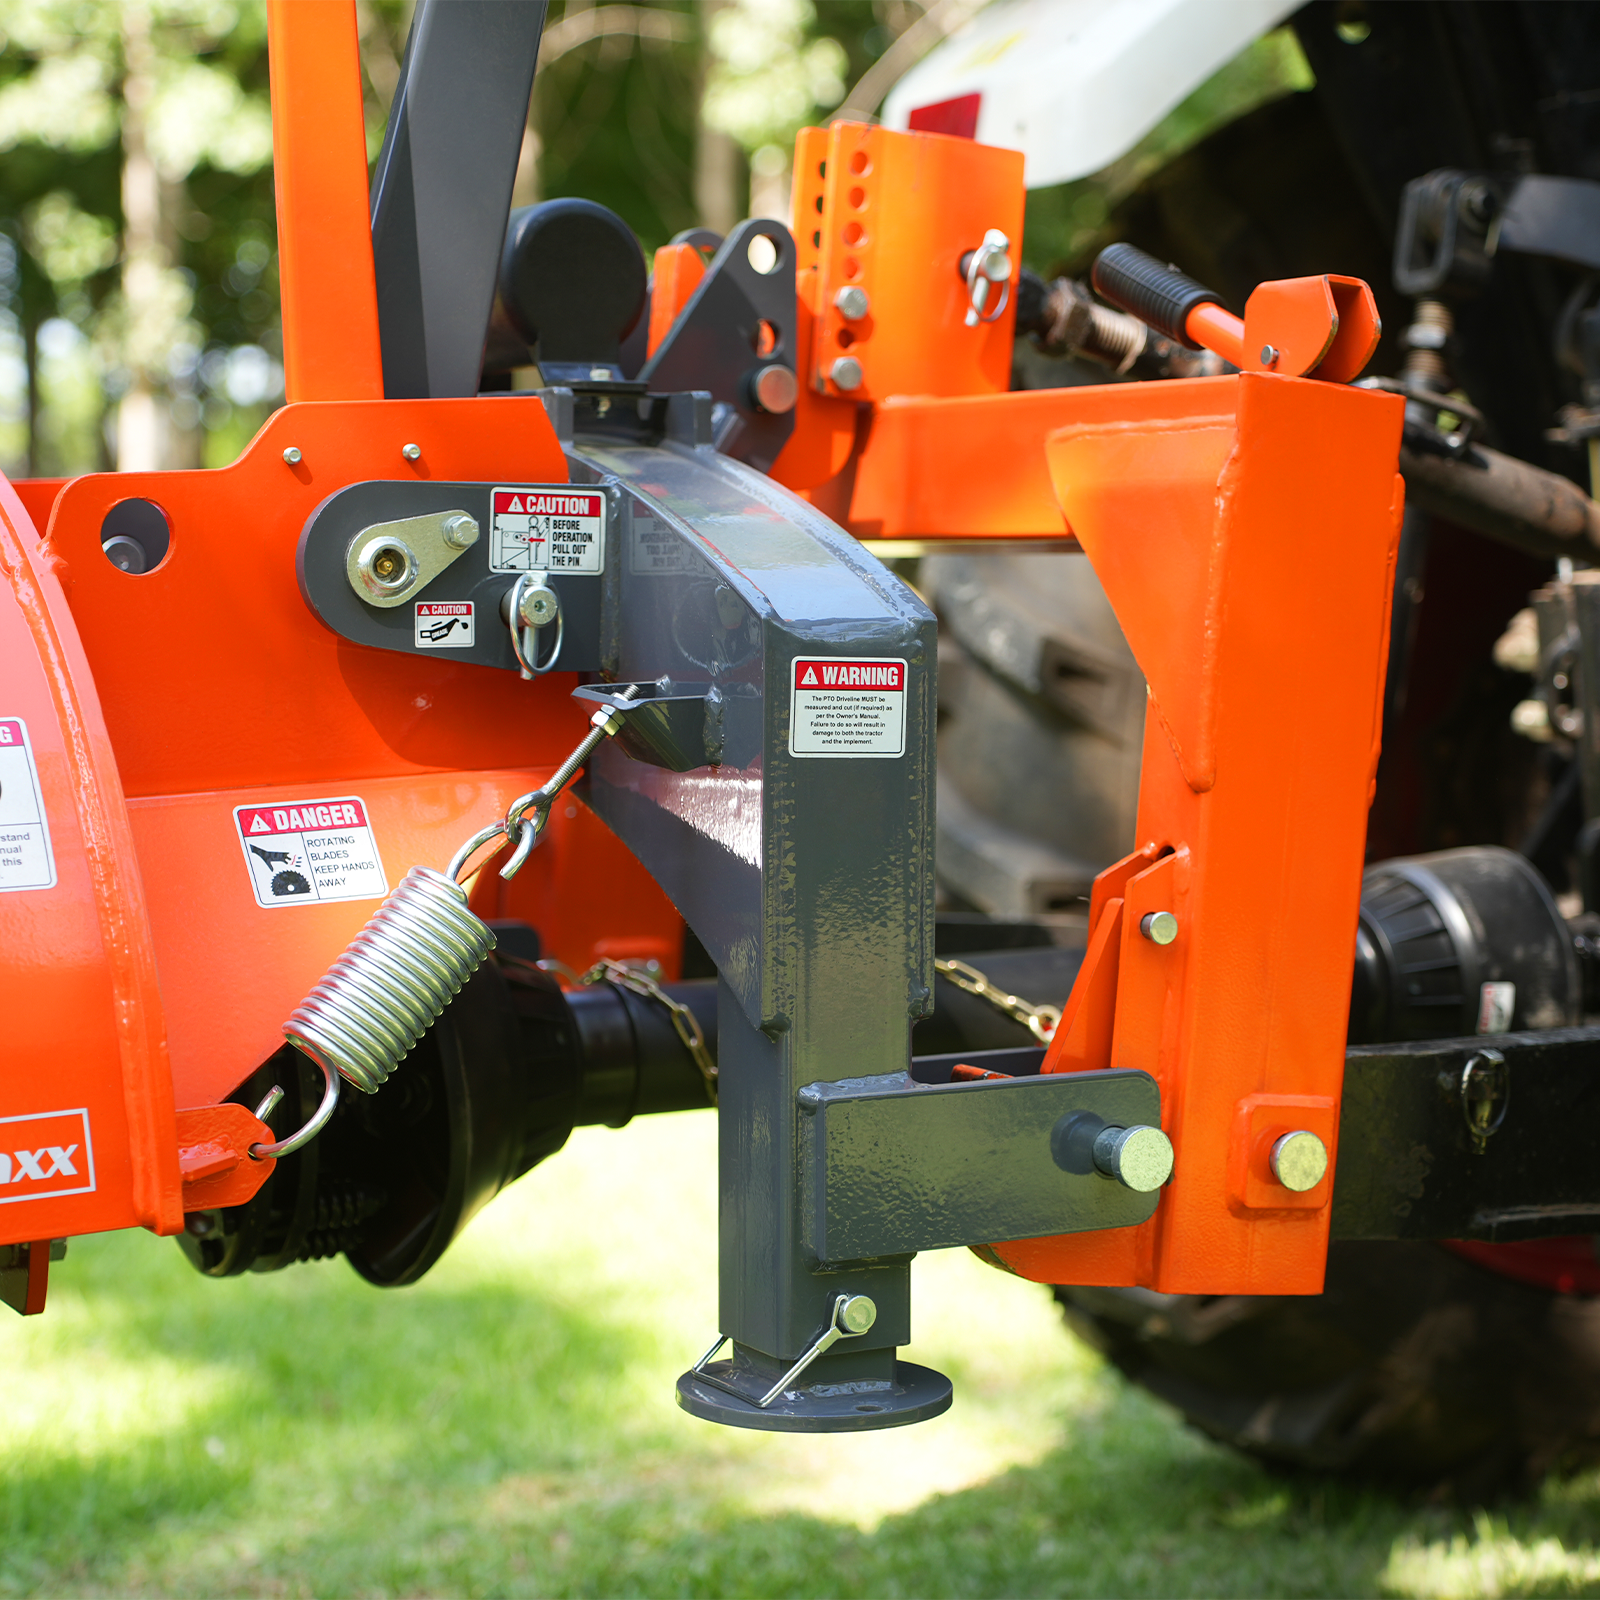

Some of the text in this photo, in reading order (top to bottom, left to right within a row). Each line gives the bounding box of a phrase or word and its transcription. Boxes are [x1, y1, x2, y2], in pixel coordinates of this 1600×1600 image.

[526, 496, 590, 515] CAUTION
[552, 520, 580, 531] BEFORE
[552, 544, 587, 555] PULL OUT
[552, 556, 565, 567] THE
[431, 605, 468, 615] CAUTION
[822, 666, 899, 686] WARNING
[273, 804, 359, 831] DANGER
[0, 832, 30, 842] stand
[306, 835, 356, 848] ROTATING
[310, 850, 349, 861] BLADES
[2, 857, 23, 867] this
[314, 861, 375, 875] KEEP HANDS
[318, 877, 347, 888] AWAY
